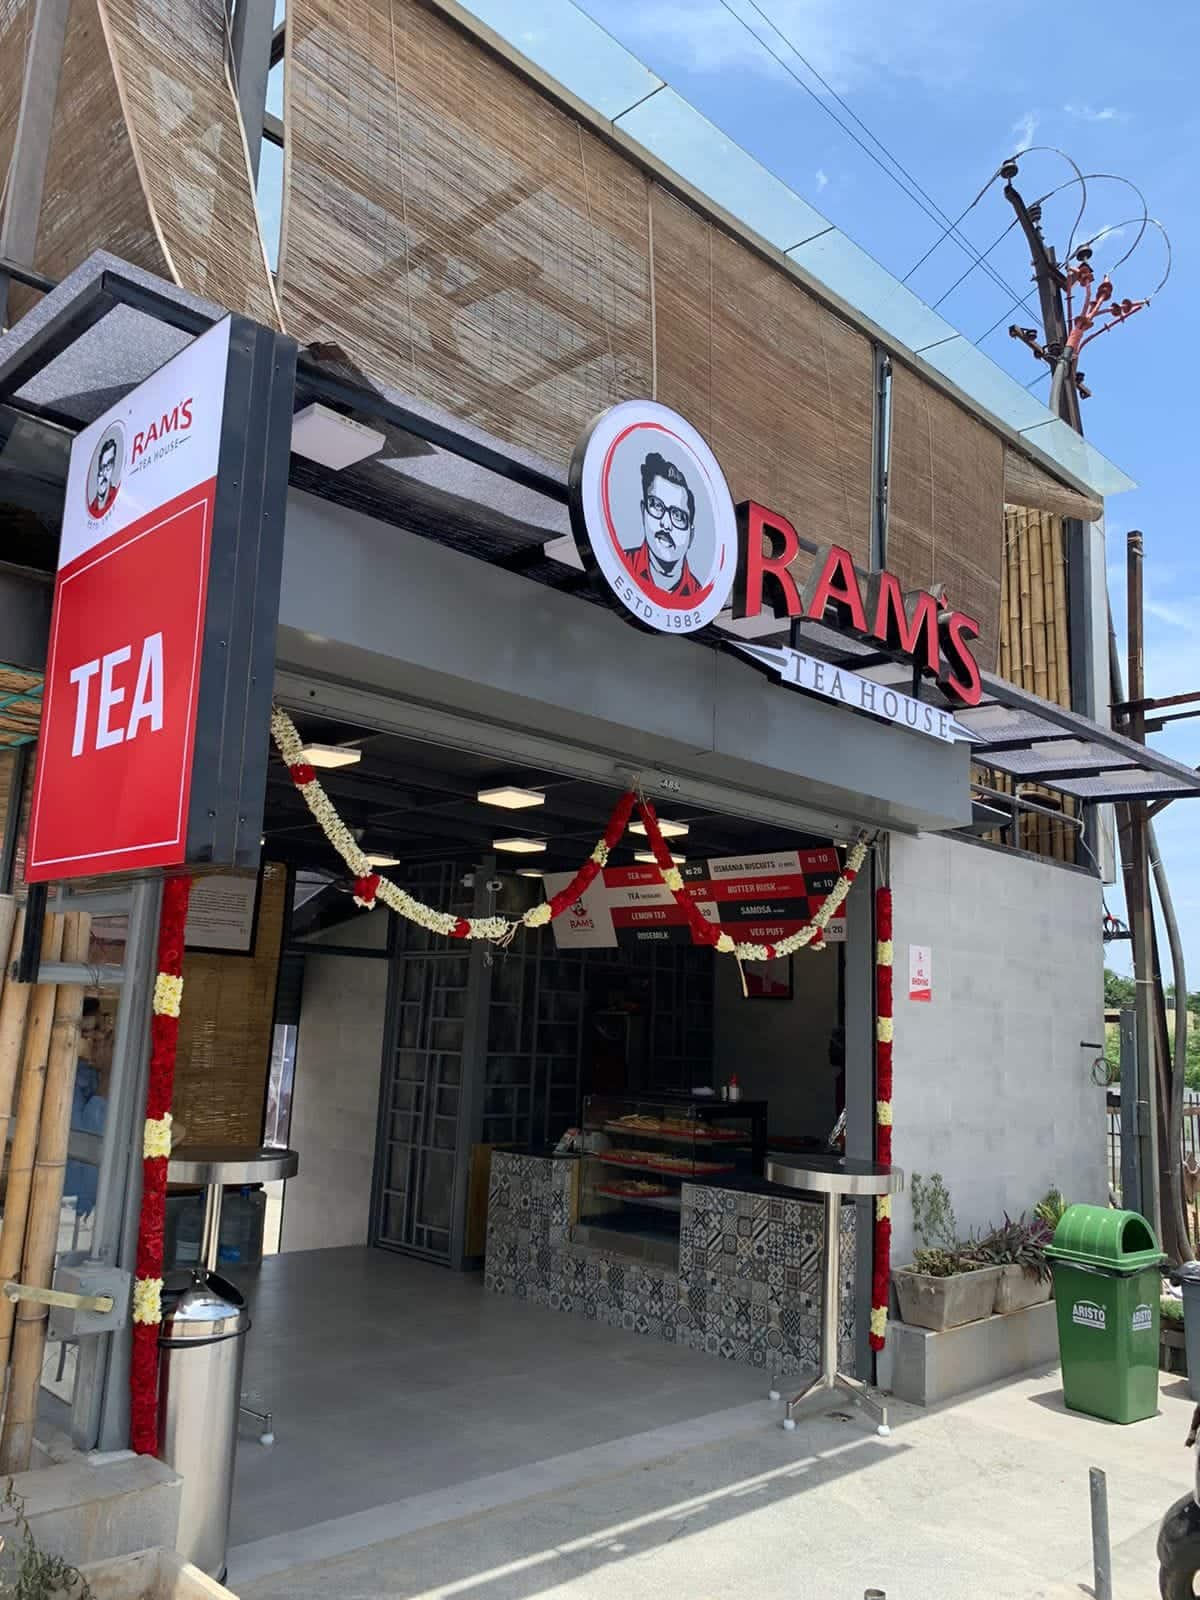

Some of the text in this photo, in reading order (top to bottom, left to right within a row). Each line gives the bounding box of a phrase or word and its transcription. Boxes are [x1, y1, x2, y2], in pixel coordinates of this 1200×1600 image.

[131, 398, 194, 464] RAM'S
[138, 439, 180, 472] TEA HOUSE
[614, 575, 703, 628] ESTD 1982
[733, 500, 983, 706] RAM'S
[70, 631, 164, 757] TEA
[789, 652, 952, 740] TEA HOUSE
[818, 854, 829, 863] 10
[627, 872, 640, 880] TEA
[693, 867, 703, 875] 20
[727, 884, 756, 894] BUTTER
[756, 882, 777, 892] RUSK
[823, 879, 834, 888] 10
[628, 892, 640, 901] TEA
[631, 912, 653, 921] LEMON
[654, 911, 667, 920] TEA
[740, 904, 772, 915] SAMOSA
[750, 927, 765, 937] VEG
[766, 927, 785, 936] PUFF
[832, 926, 843, 934] 20
[1072, 1303, 1106, 1322] ARISTO
[1132, 1310, 1152, 1323] ARISTO
